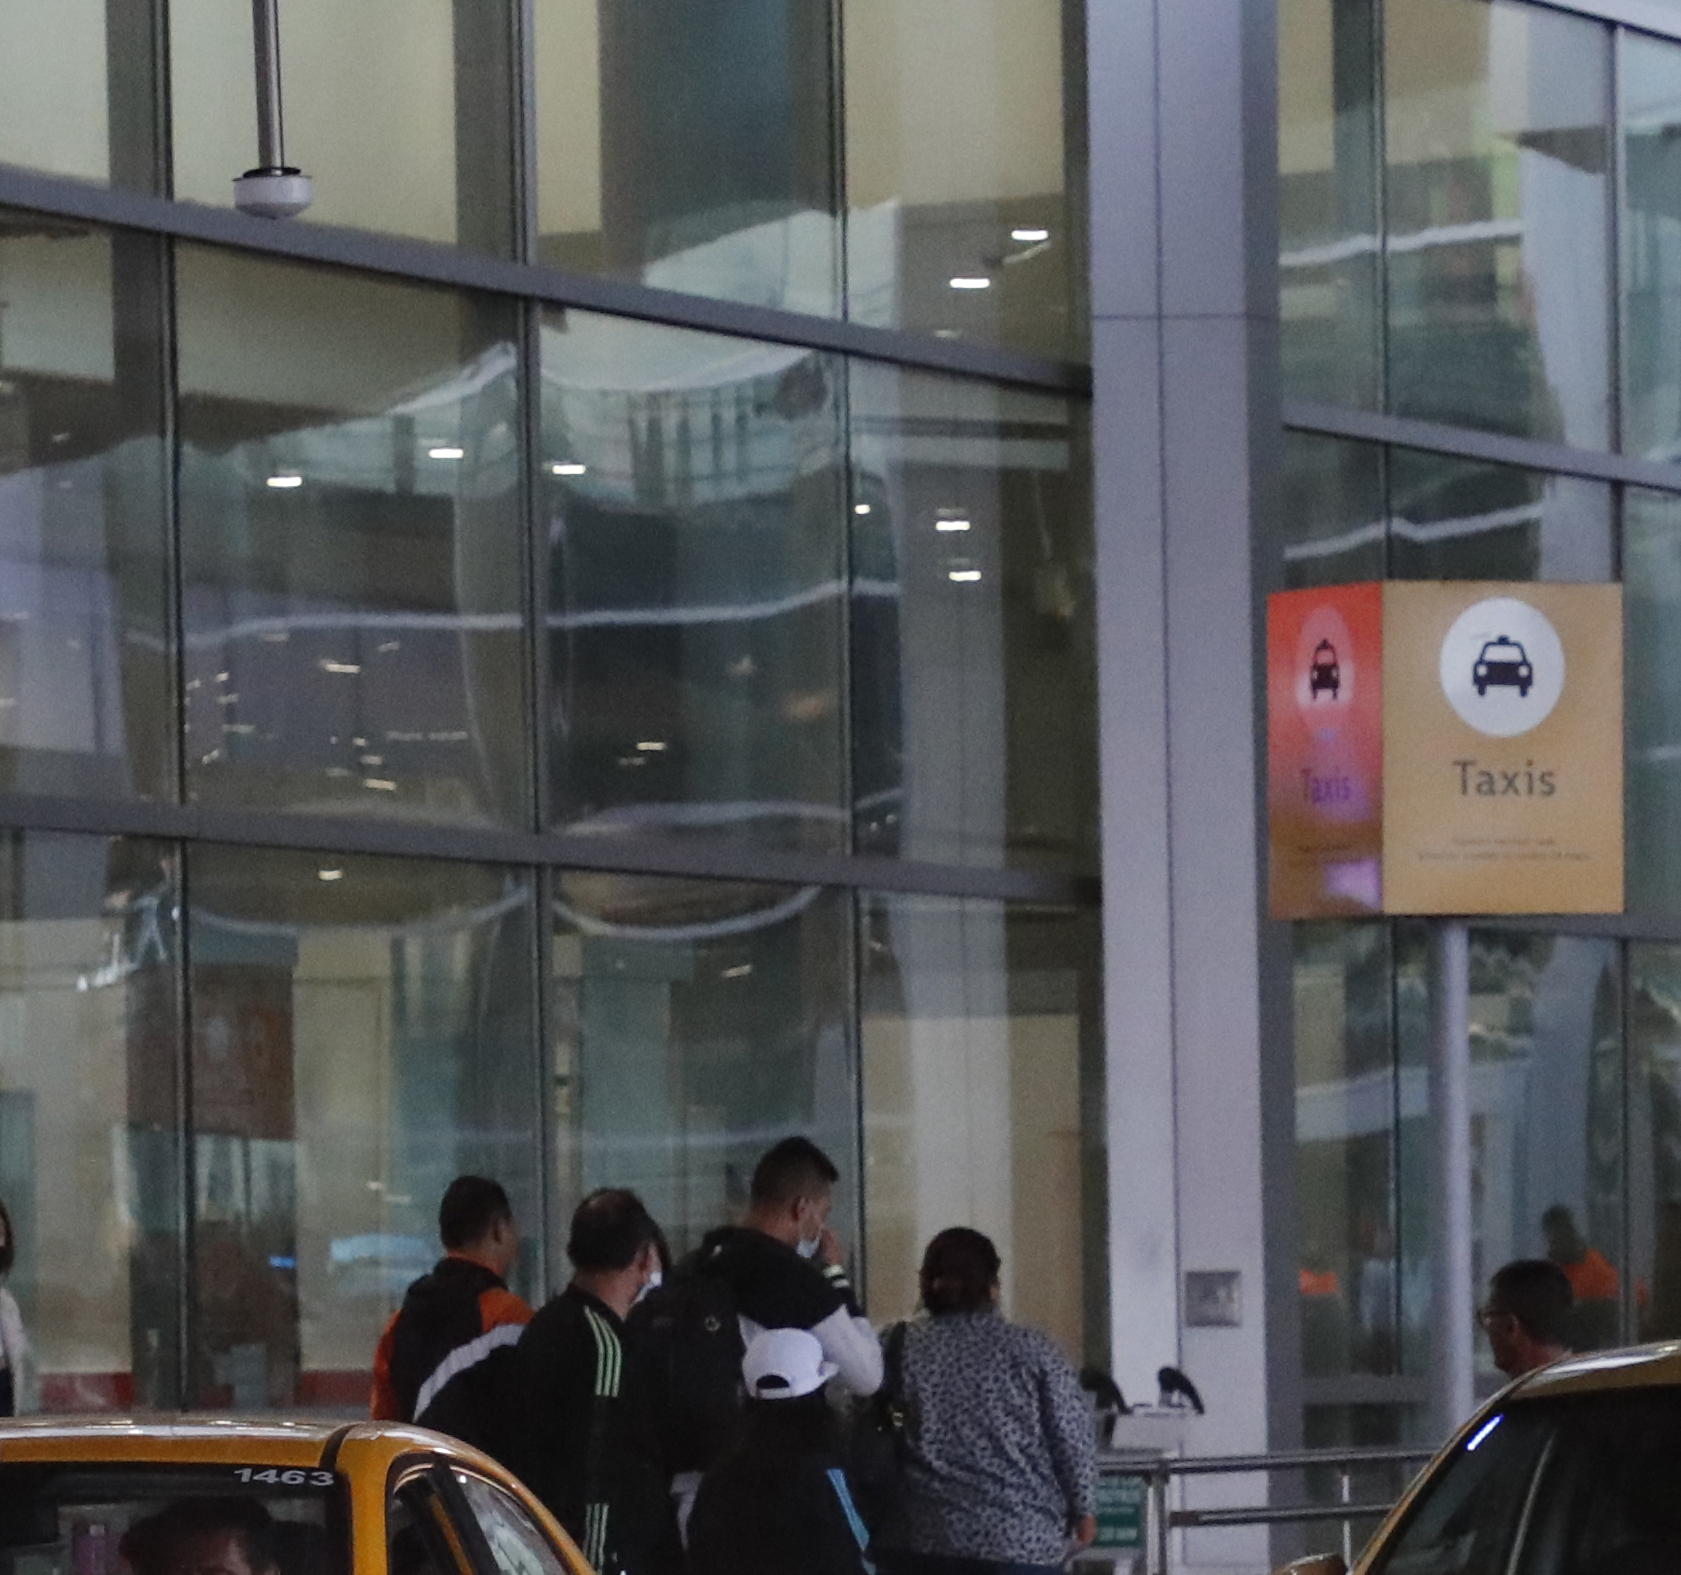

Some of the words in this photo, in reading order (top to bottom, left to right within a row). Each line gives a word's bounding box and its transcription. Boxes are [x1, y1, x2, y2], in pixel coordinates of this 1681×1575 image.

[1300, 766, 1352, 804] Taxis
[1452, 757, 1558, 798] Taxis
[233, 1467, 335, 1487] 1463
